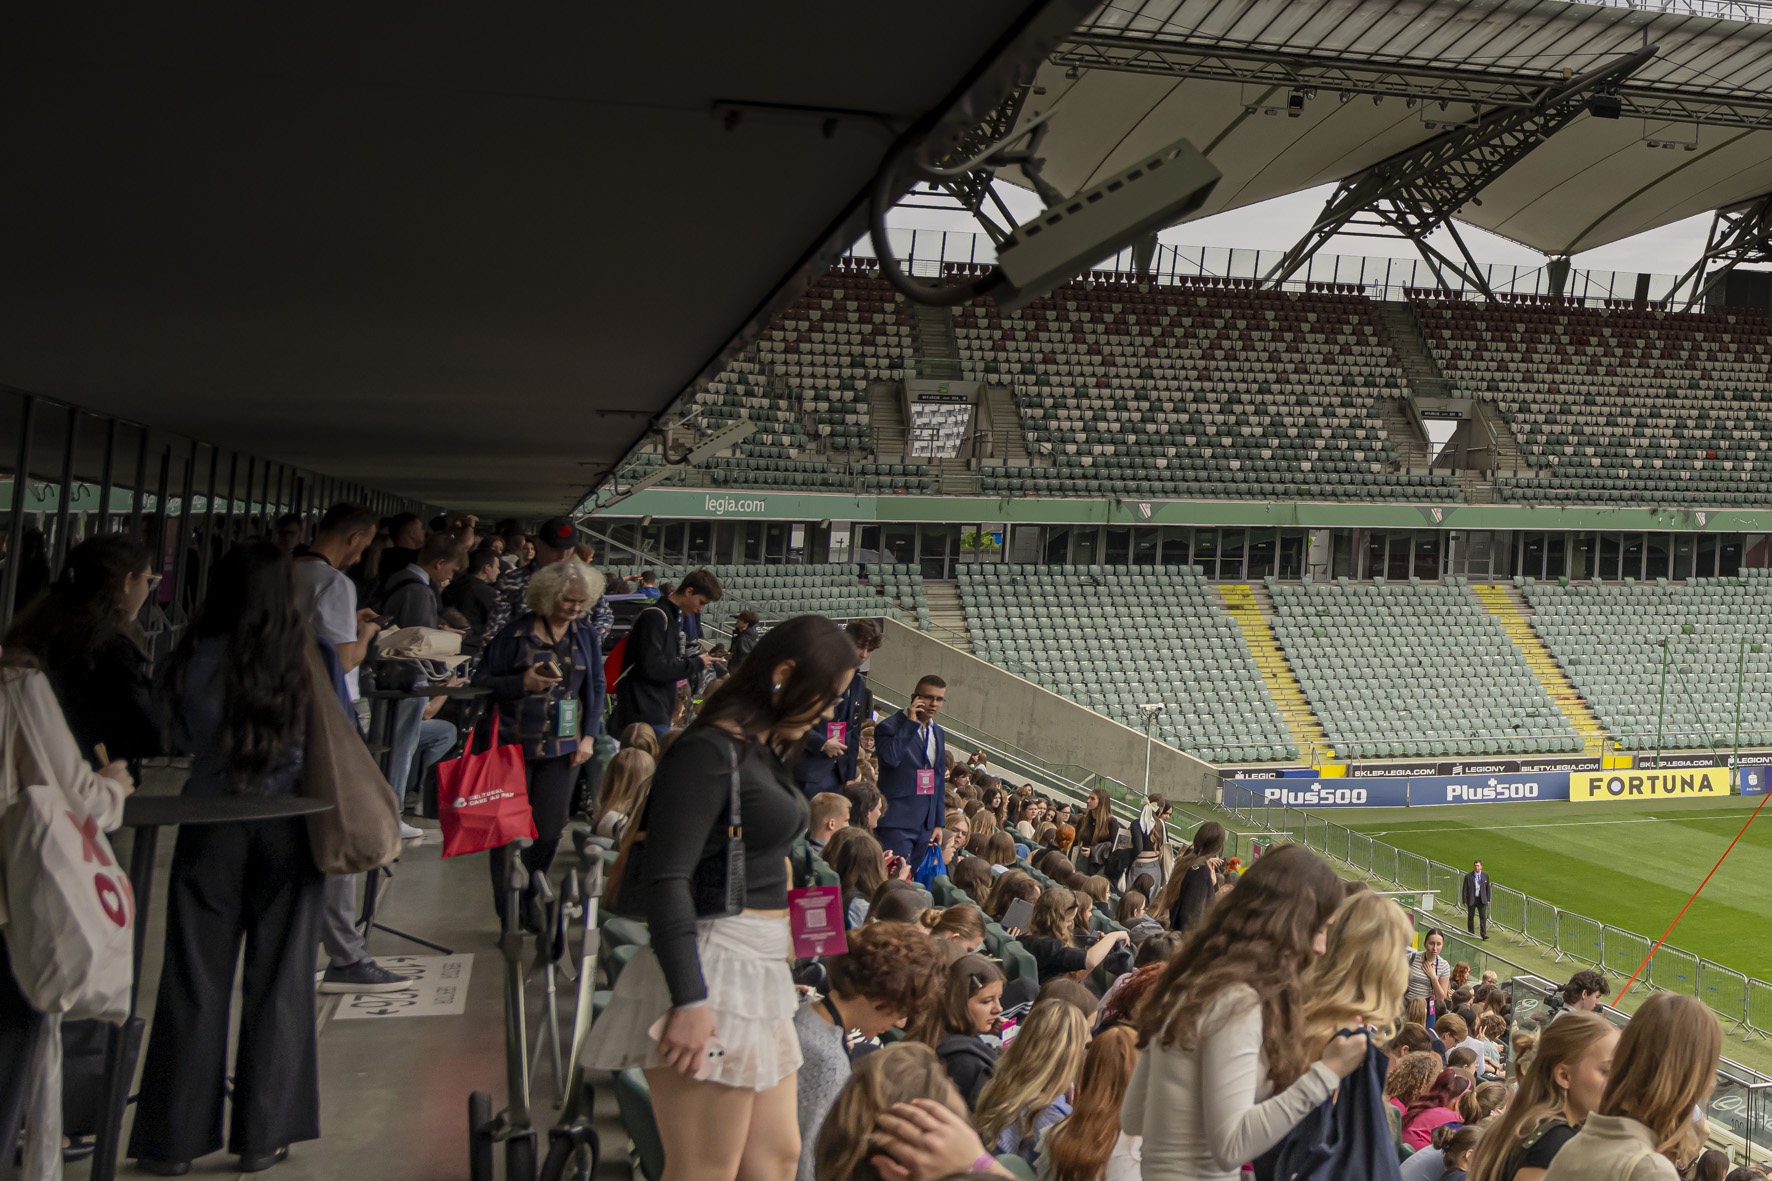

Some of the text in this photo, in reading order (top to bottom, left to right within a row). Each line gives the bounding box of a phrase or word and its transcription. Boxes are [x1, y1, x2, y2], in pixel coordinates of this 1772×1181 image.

[705, 494, 765, 515] legia.com
[1354, 768, 1435, 778] SKLEP.LEGIA.COM
[1465, 765, 1505, 773] LEGIONY
[1521, 763, 1599, 772] BILETY.LEGIA.COM
[1446, 781, 1538, 801] Plus500
[1588, 774, 1714, 797] FORTUNA
[1264, 786, 1367, 804] Plus500
